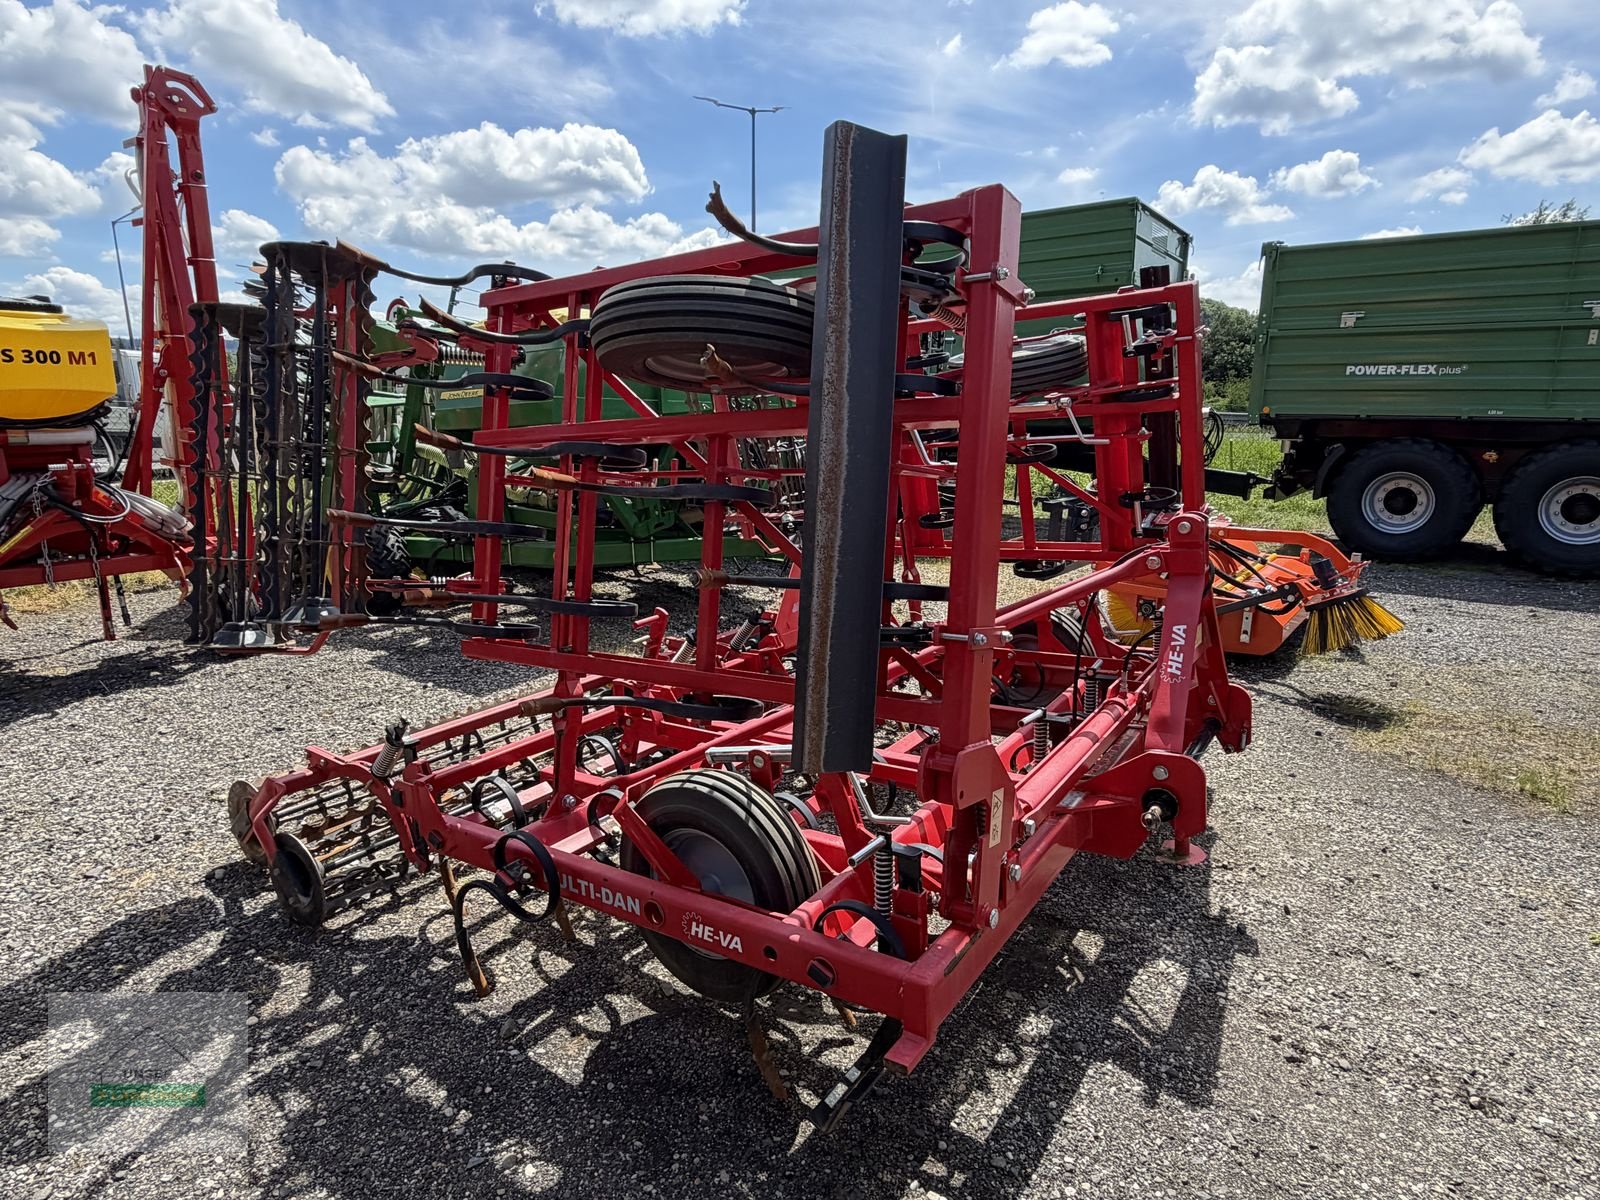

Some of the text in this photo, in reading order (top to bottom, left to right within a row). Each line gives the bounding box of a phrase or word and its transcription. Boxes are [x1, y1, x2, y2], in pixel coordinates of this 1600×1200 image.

[21, 349, 61, 364] 300
[67, 351, 97, 365] M1
[1345, 364, 1438, 375] POWER-FLEX
[1167, 625, 1187, 675] HE-VA
[552, 871, 640, 916] ULTI-DAN
[691, 921, 743, 953] HE-VA
